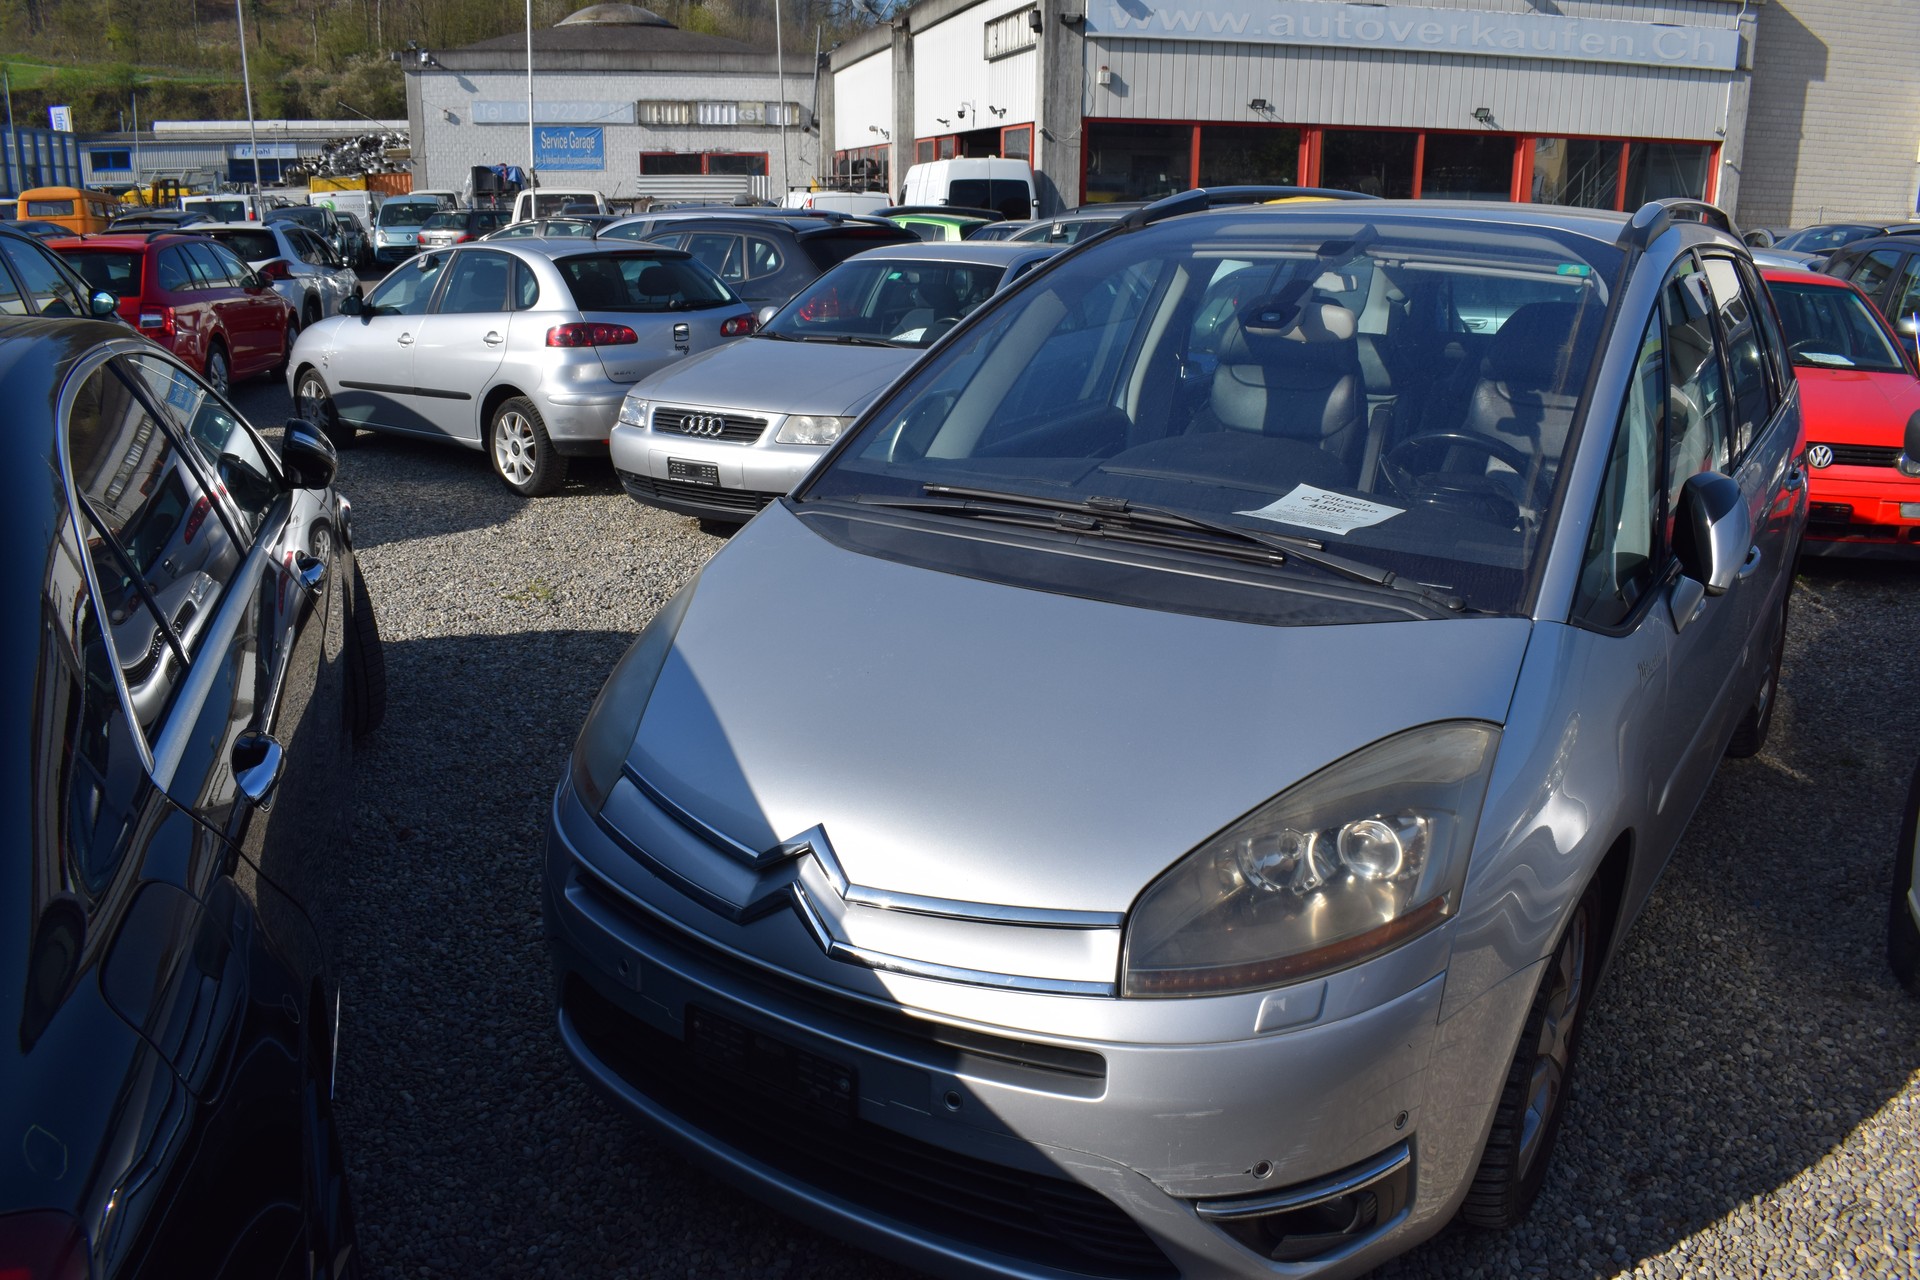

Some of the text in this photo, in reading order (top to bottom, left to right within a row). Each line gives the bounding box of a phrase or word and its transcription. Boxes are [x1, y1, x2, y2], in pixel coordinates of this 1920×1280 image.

[550, 103, 578, 119] 922
[584, 103, 602, 119] 22
[541, 131, 595, 153] Service Garage
[1323, 500, 1378, 513] Picasso
